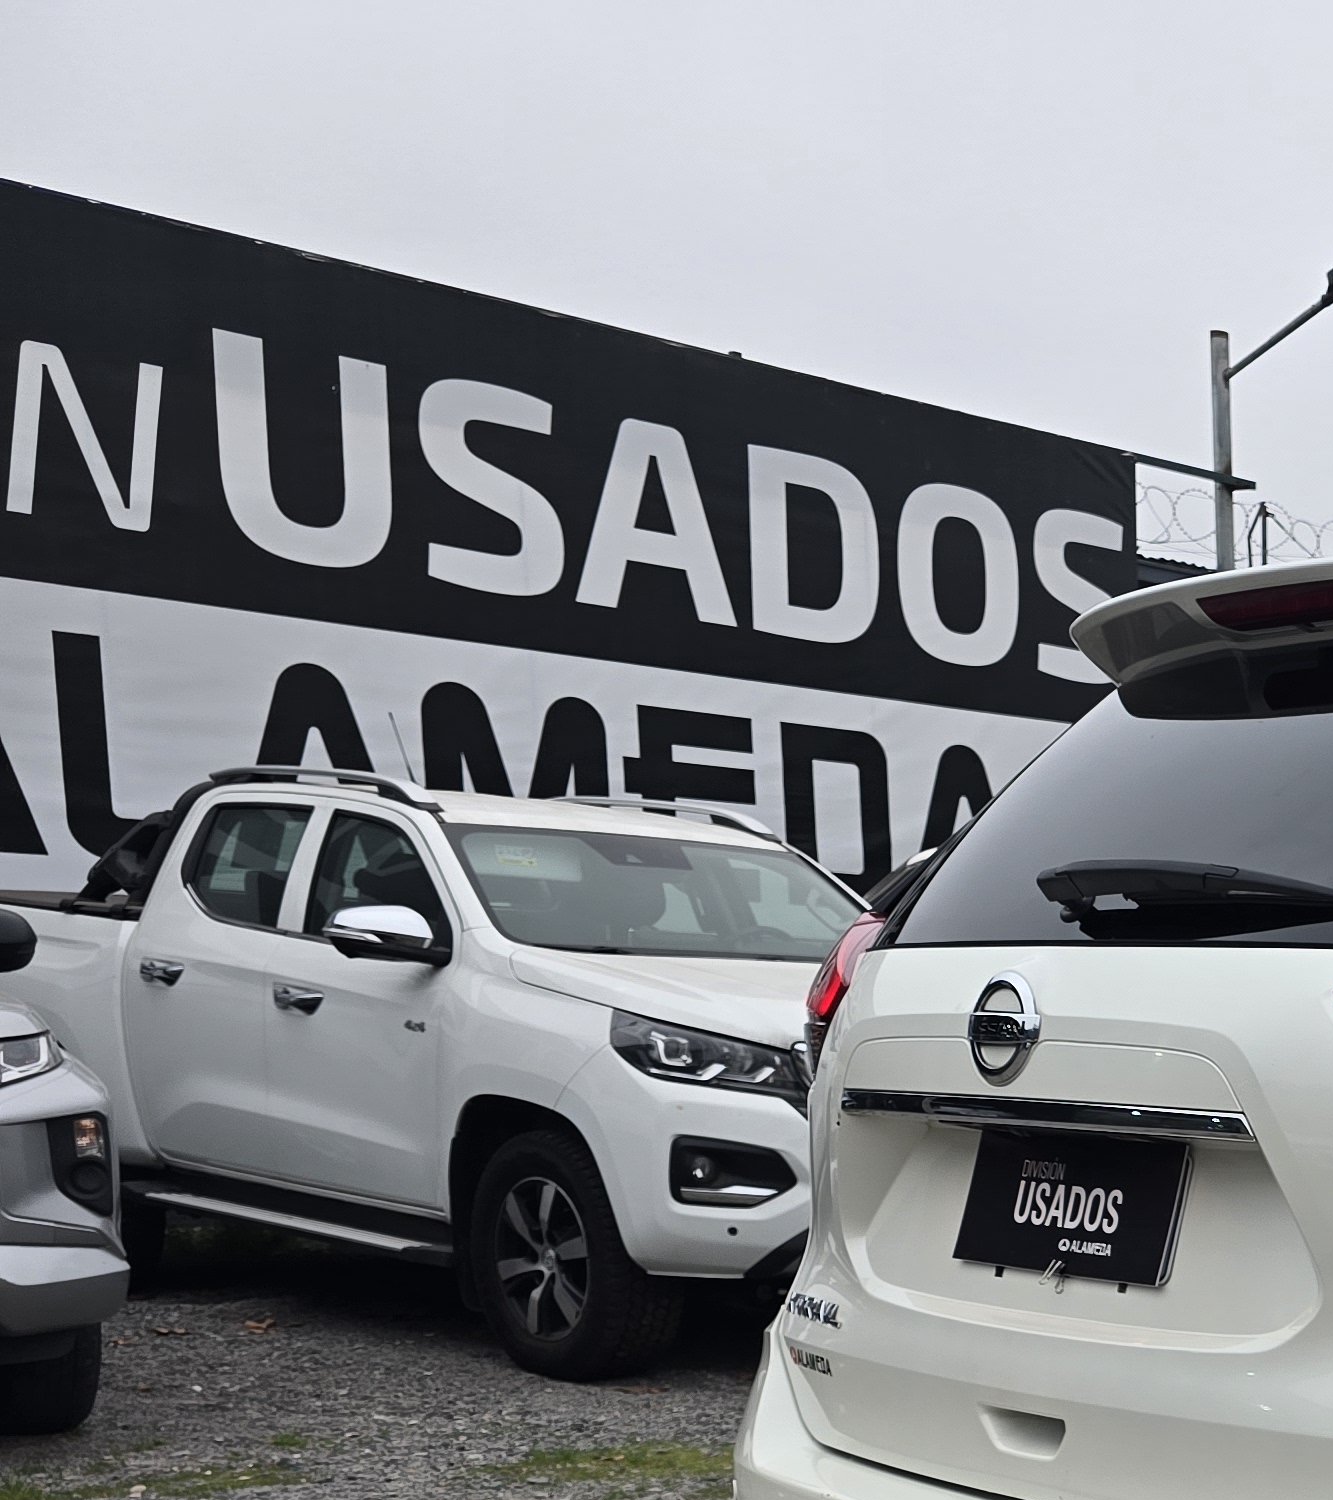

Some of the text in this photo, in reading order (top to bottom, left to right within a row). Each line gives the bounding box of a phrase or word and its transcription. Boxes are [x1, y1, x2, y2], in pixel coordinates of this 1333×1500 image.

[212, 328, 1123, 684] USADOS
[1021, 1157, 1067, 1181] DIVISIÓN
[1013, 1180, 1124, 1234] USADOS
[1069, 1239, 1112, 1257] ALAMEDA
